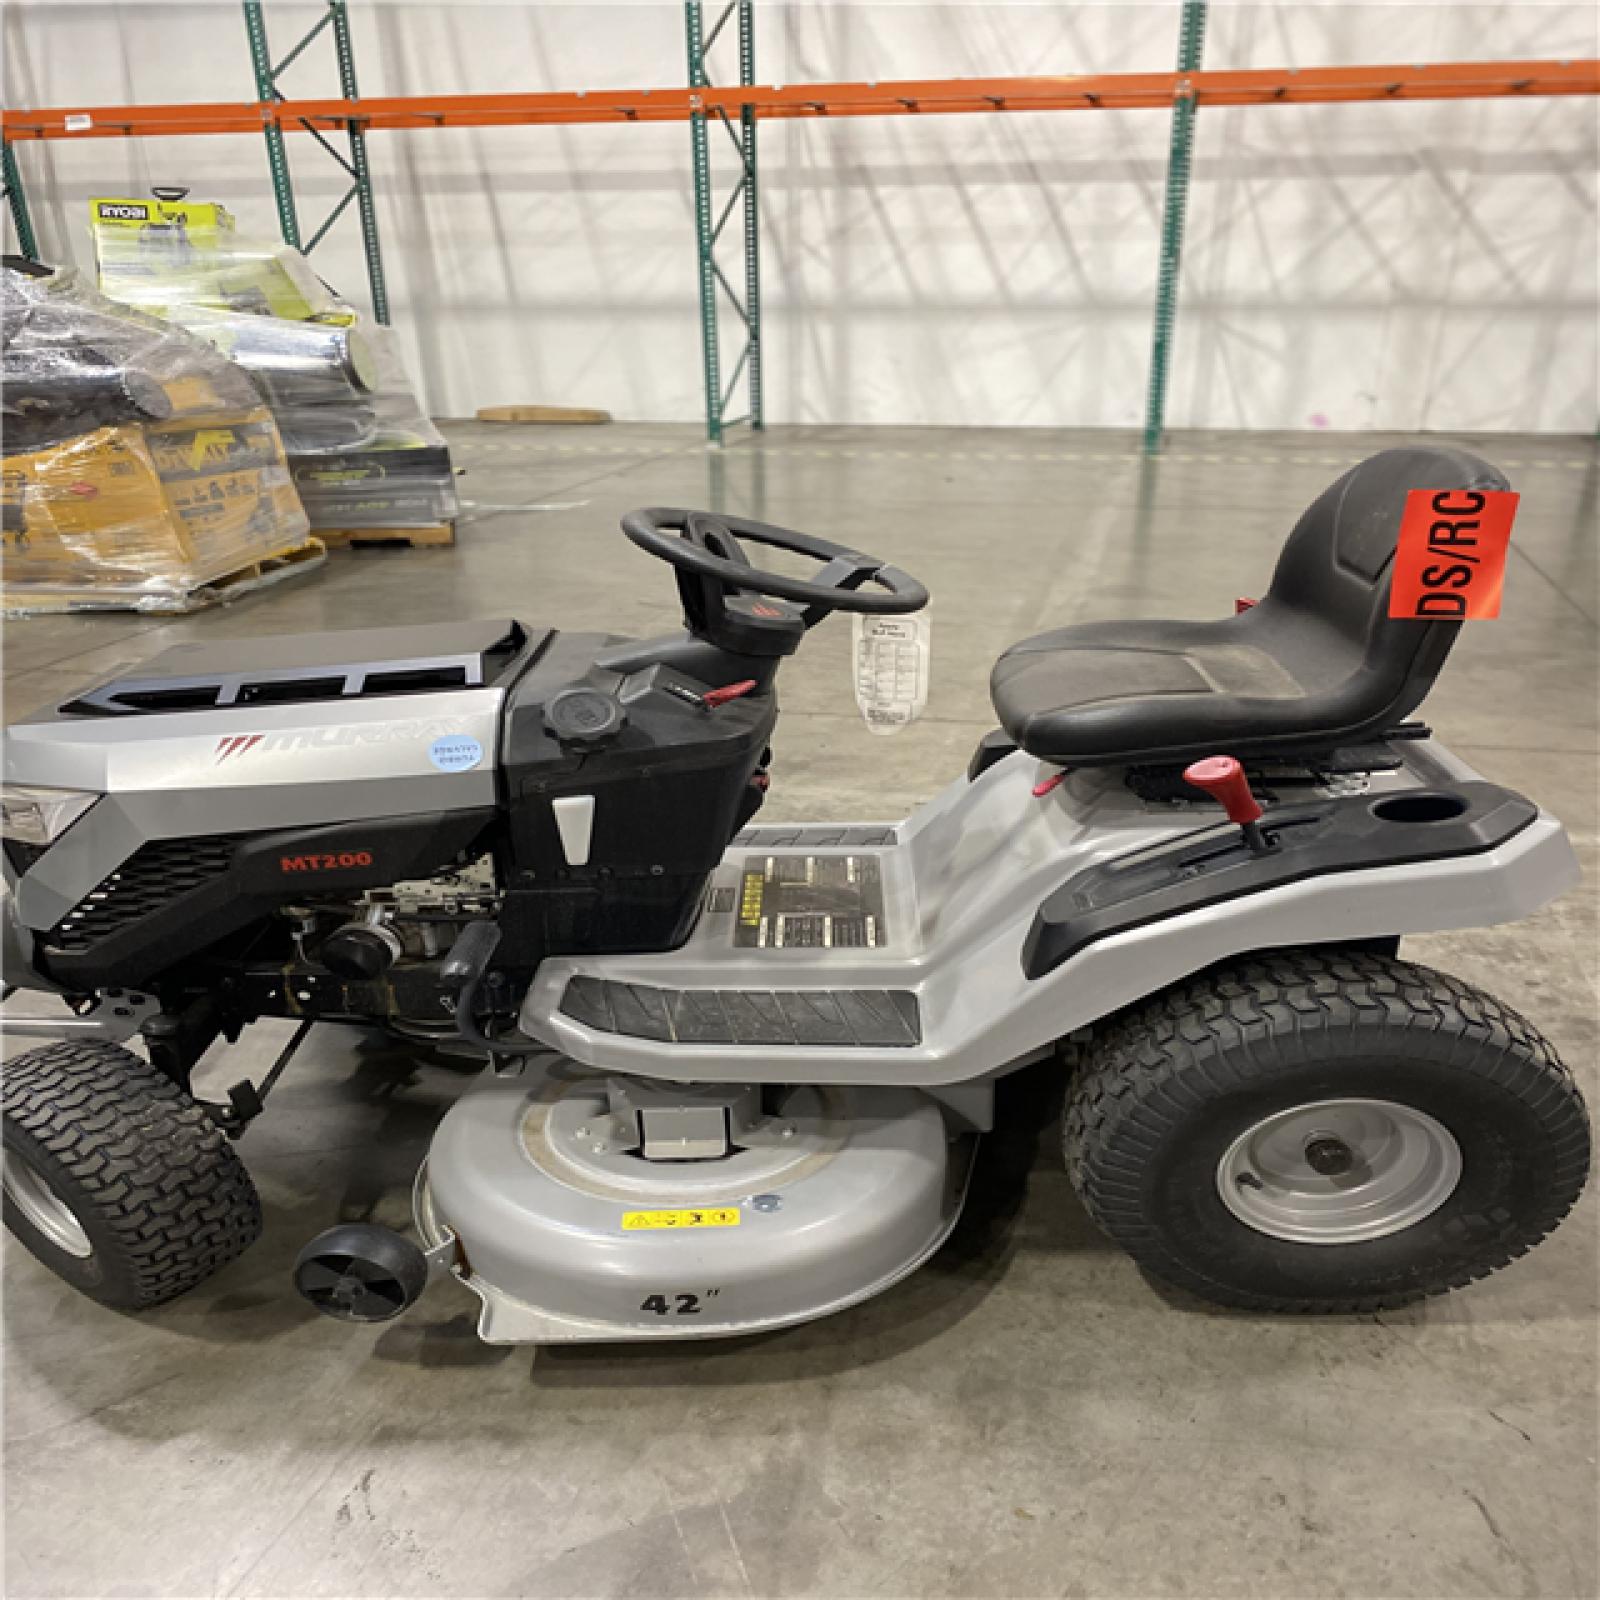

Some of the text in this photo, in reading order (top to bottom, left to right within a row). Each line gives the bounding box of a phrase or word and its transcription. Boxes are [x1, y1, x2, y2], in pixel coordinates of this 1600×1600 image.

[1416, 491, 1486, 616] DS/RC
[280, 851, 373, 873] MT200
[640, 1287, 720, 1315] 42"
